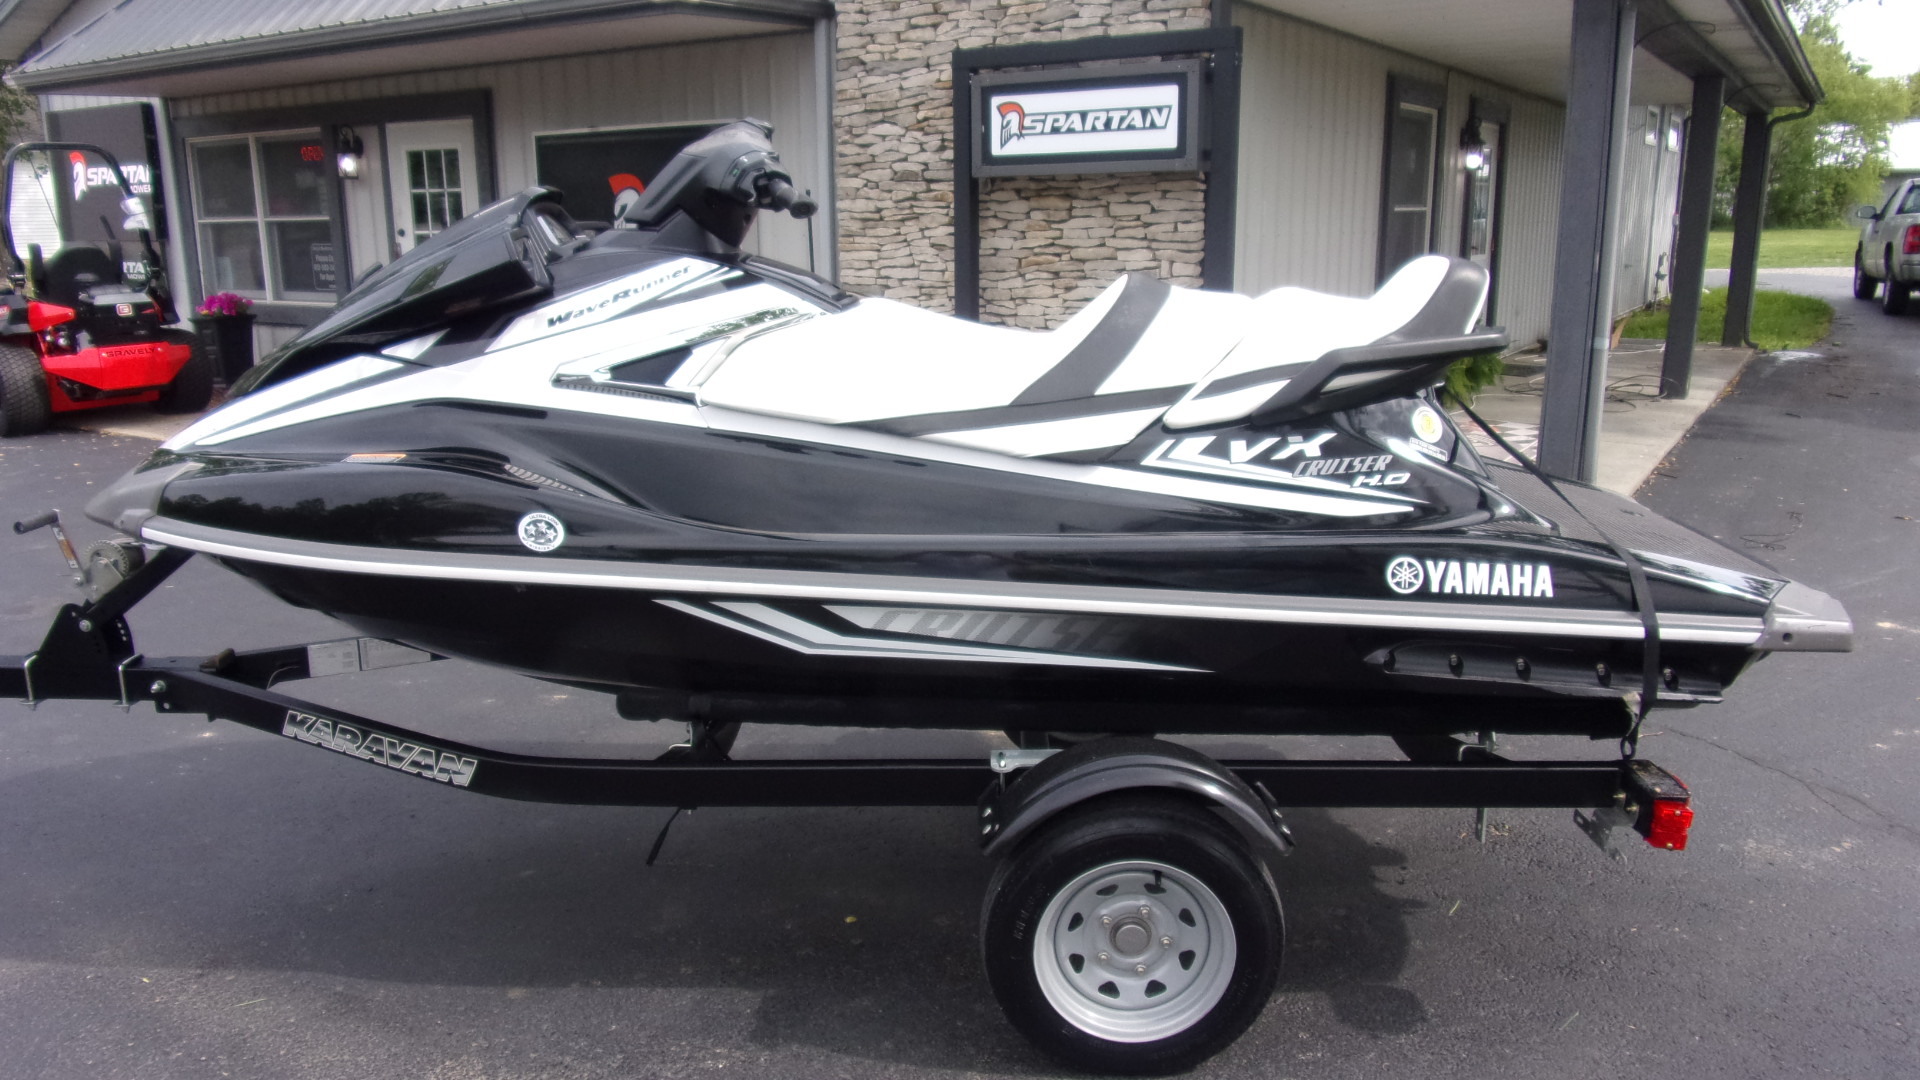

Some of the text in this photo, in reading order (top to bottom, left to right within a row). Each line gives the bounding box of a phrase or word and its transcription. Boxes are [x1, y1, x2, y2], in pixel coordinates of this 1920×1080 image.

[1022, 106, 1171, 134] SPARTAN
[546, 265, 691, 328] WaveRunner
[106, 346, 155, 358] GRAVELY
[1292, 455, 1393, 478] CRUISER
[1425, 560, 1554, 598] YAMAHA
[282, 710, 477, 787] KARAVAN
